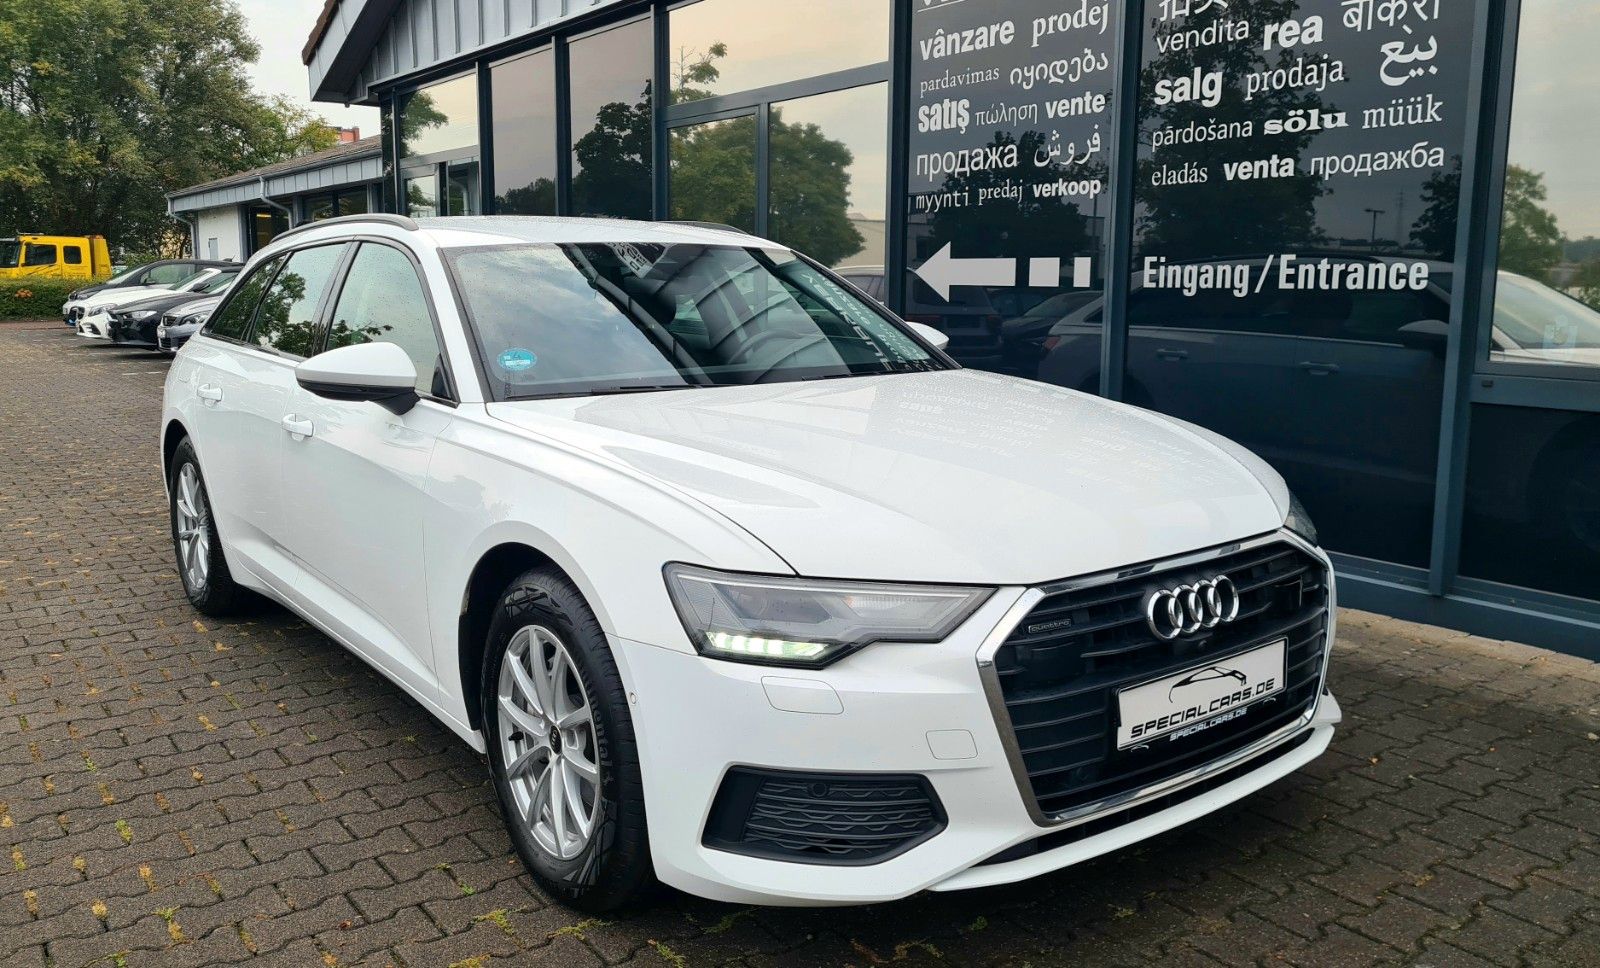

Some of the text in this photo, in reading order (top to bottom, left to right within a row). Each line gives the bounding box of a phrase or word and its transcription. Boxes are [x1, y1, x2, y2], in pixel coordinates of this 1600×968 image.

[920, 21, 1015, 60] vânzare
[1031, 0, 1108, 47] prodej
[1157, 14, 1323, 53] vendita rea
[920, 68, 999, 98] pardavimas
[1010, 48, 1108, 89] იყიდება
[1154, 54, 1344, 107] salg prodaja
[918, 98, 970, 134] satış
[975, 103, 1038, 126] πώληση
[1046, 91, 1105, 119] vente
[1152, 94, 1443, 152] pārdošana sölu müük
[916, 144, 1018, 182] продажа
[1033, 123, 1101, 167] فروش
[1310, 142, 1445, 180] продажба
[1151, 154, 1295, 186] eladás venta
[916, 178, 1101, 213] myynti predaj verkoop
[1143, 256, 1250, 298] Eingang
[1278, 254, 1430, 291] Entrance
[1130, 678, 1276, 739] SPECIALCARS.DE
